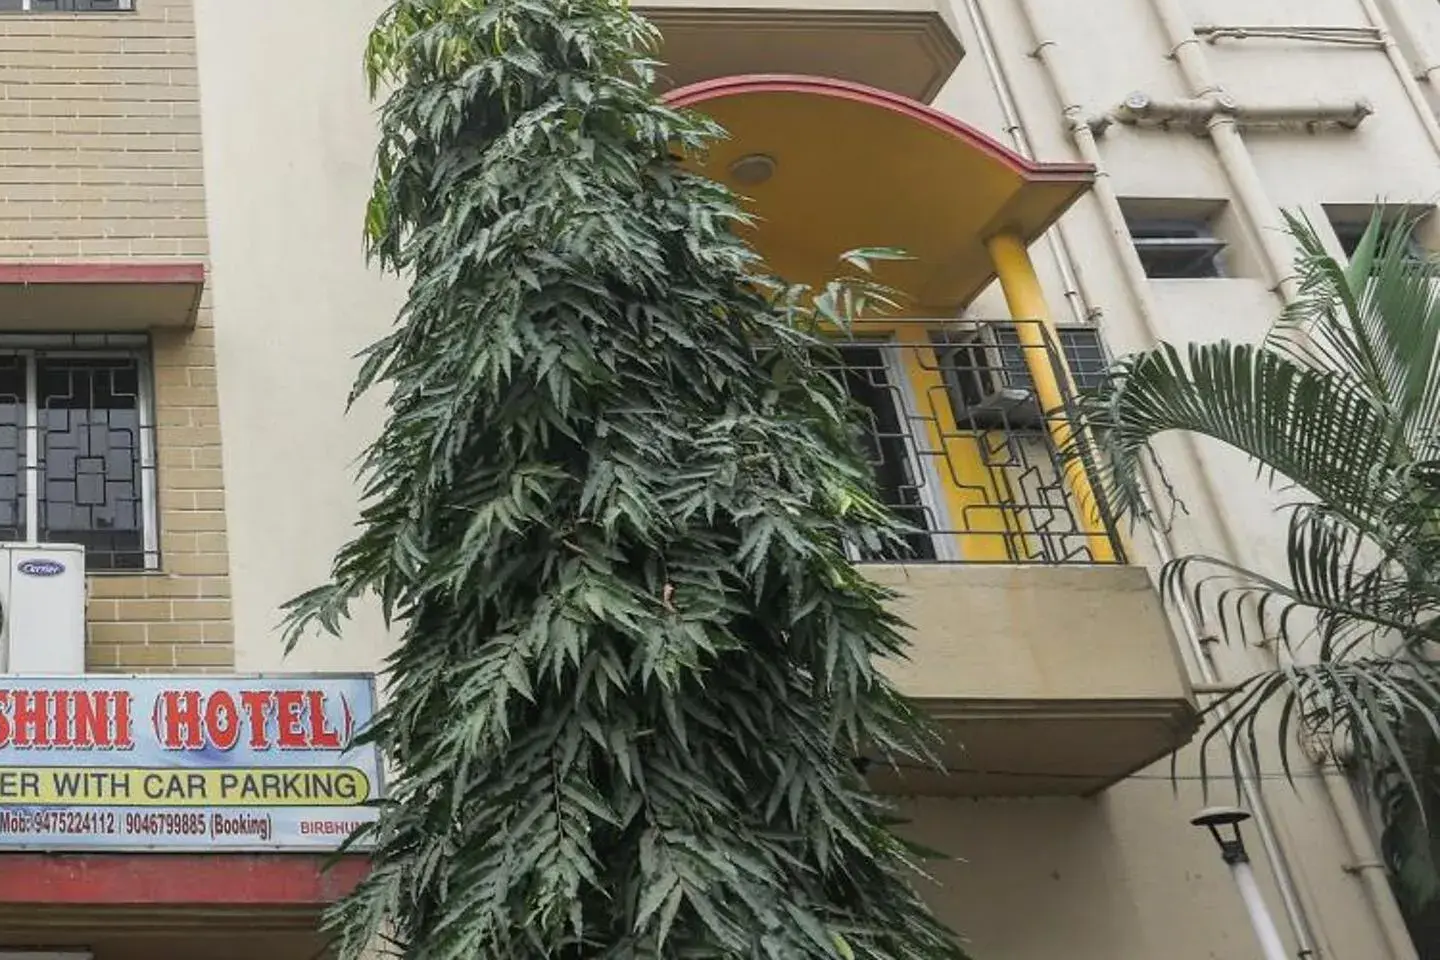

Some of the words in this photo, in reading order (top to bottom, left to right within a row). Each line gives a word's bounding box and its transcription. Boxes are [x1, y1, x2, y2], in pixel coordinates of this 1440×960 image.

[151, 690, 353, 747] (HOTEL)
[53, 772, 130, 798] WITH
[143, 773, 206, 799] CAR
[220, 773, 357, 800] PARKING
[126, 813, 206, 836] 9046799885
[210, 813, 272, 840] (Booking)
